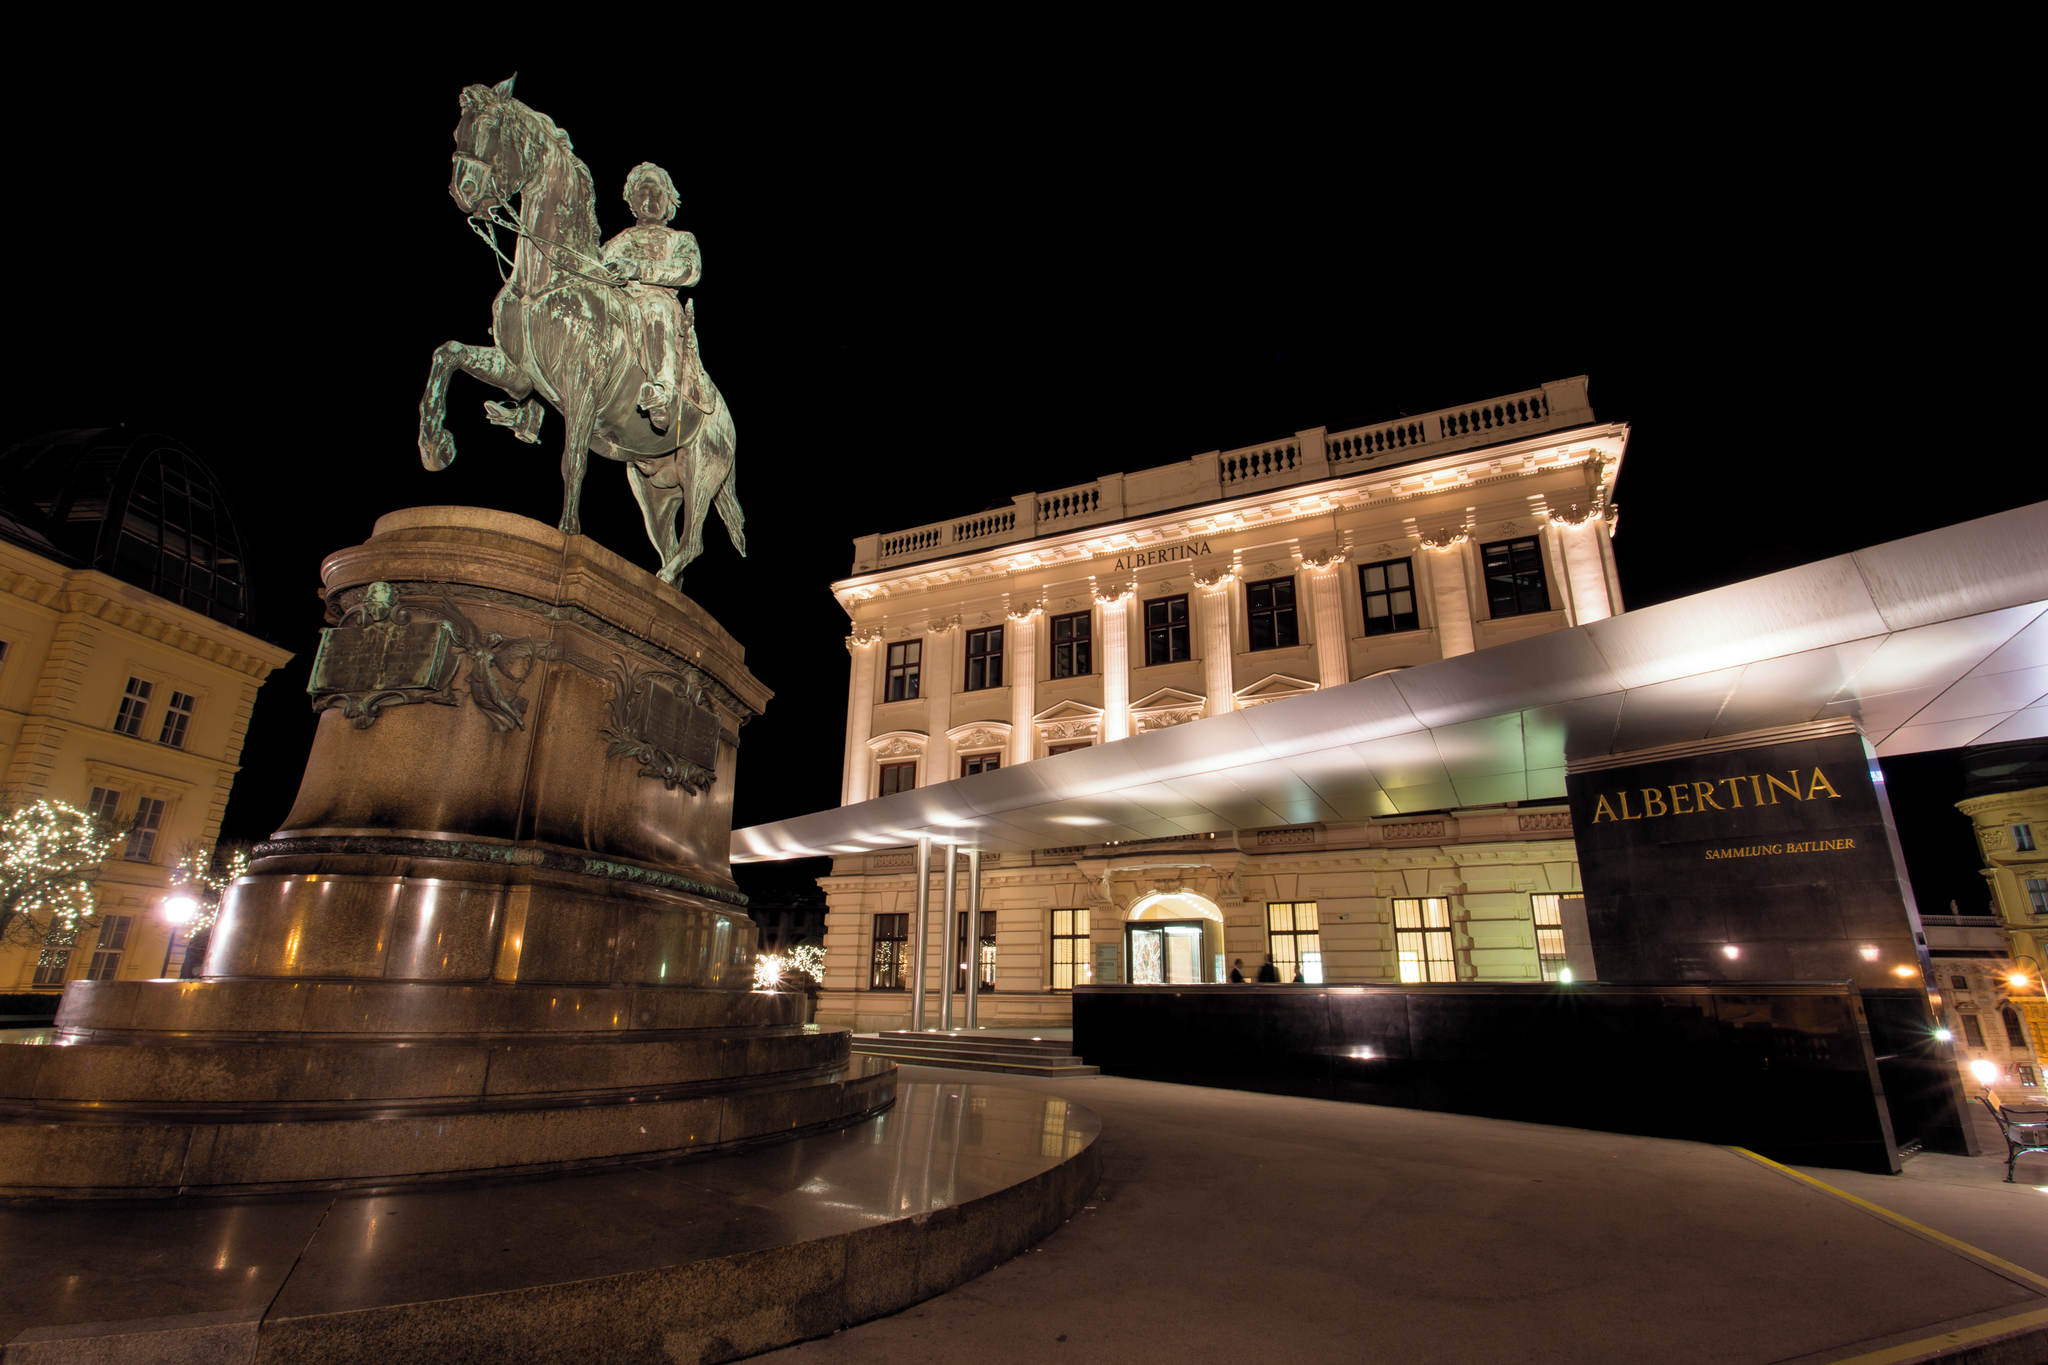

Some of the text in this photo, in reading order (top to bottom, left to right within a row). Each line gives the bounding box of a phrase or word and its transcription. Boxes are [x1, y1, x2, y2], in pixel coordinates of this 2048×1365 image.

[1114, 542, 1212, 571] ALBERTINA
[1592, 767, 1840, 823] ALBERTINA
[1705, 838, 1856, 860] SAMMLUNG BATLINER
